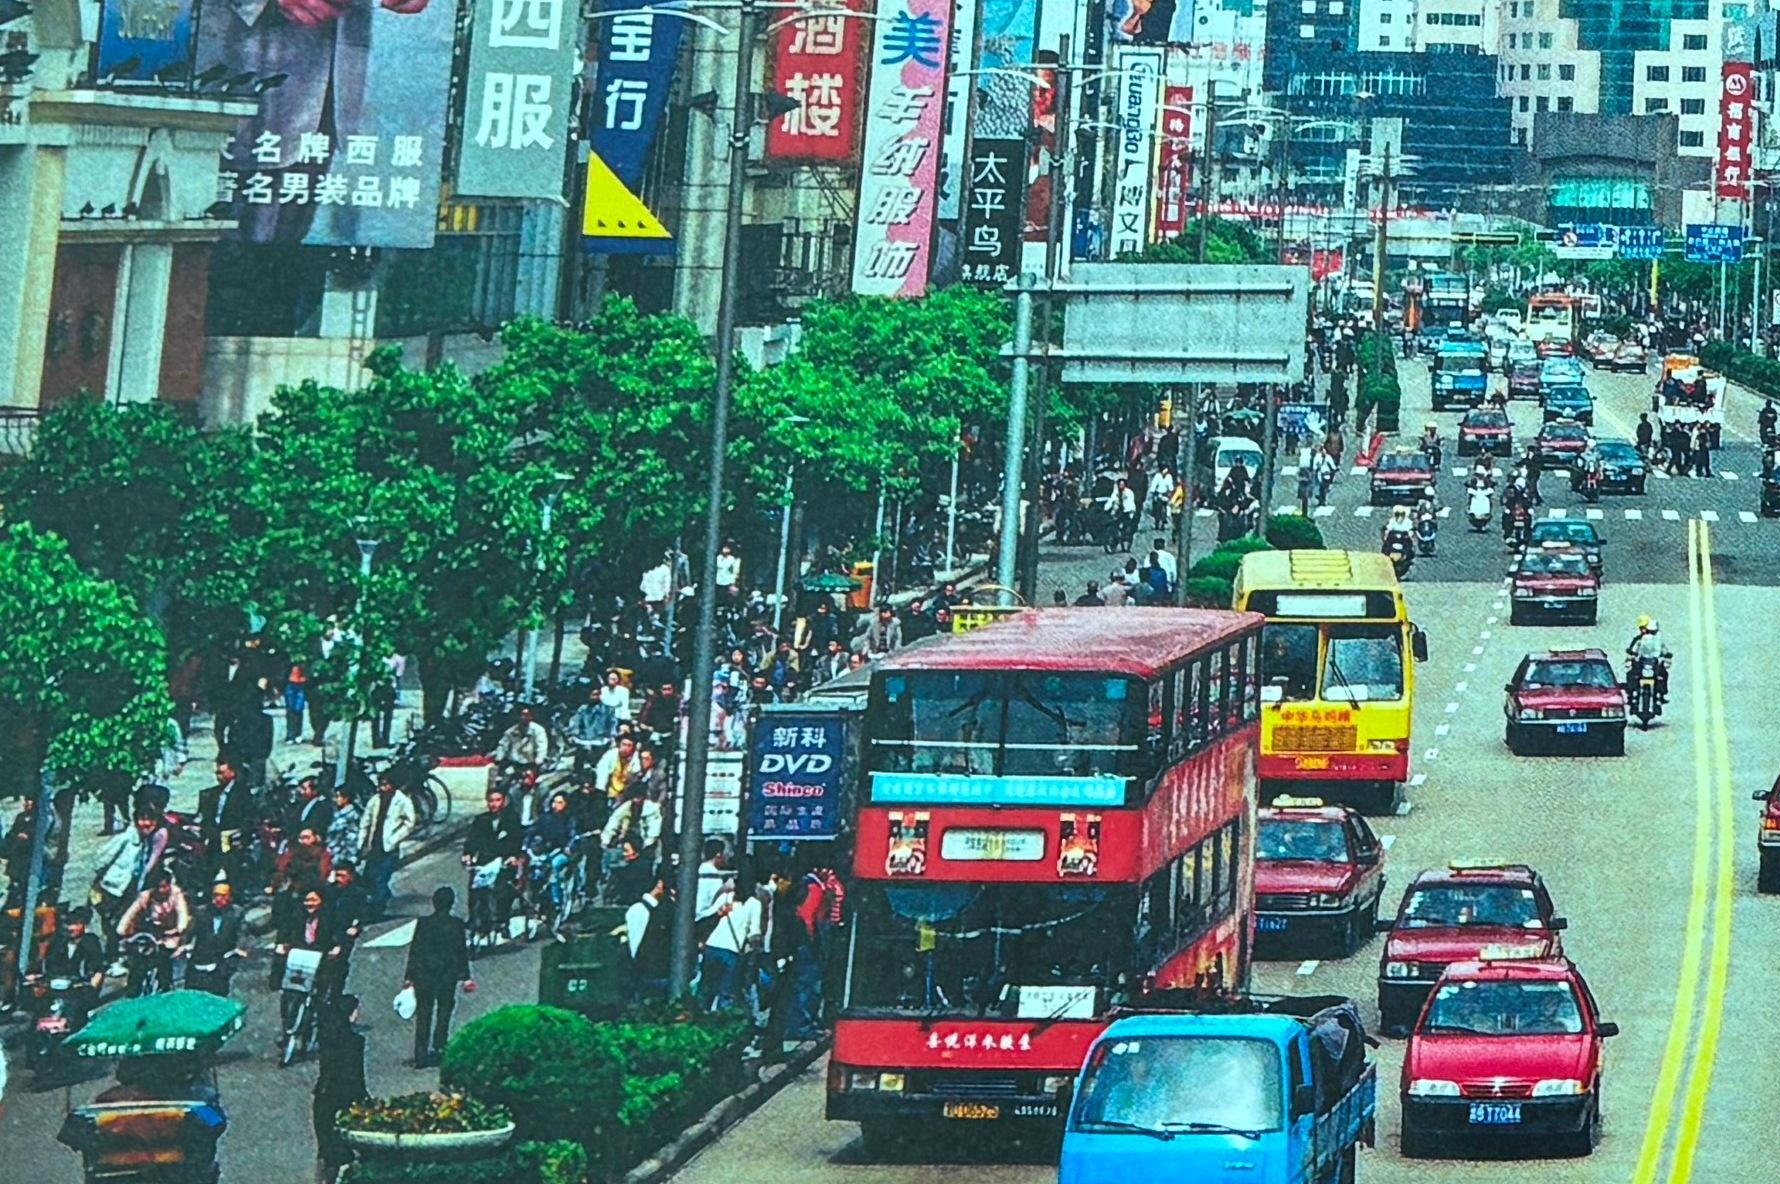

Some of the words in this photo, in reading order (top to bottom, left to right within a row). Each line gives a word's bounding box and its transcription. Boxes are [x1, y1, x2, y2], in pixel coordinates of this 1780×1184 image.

[967, 151, 1009, 258] 太平鸟
[772, 726, 827, 749] 新科
[759, 754, 833, 775] DVD
